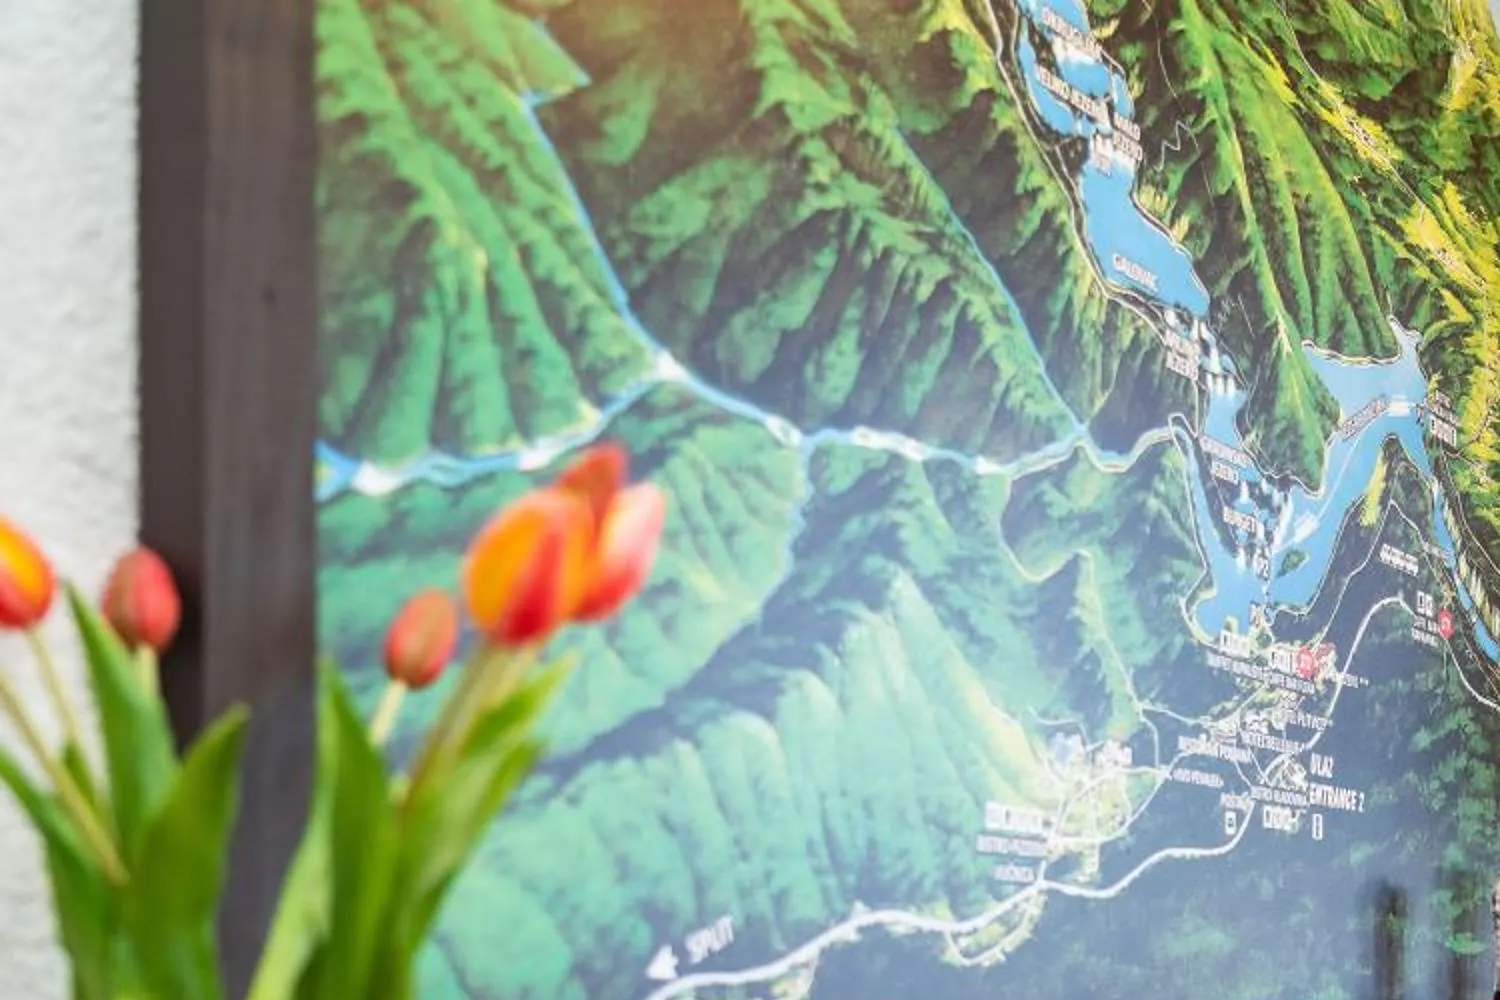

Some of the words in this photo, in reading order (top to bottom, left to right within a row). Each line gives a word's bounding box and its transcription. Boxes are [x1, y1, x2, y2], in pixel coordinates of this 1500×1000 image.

[1310, 782, 1357, 811] ENTRANCE
[1358, 791, 1366, 813] 2
[685, 914, 734, 964] SPLIT
